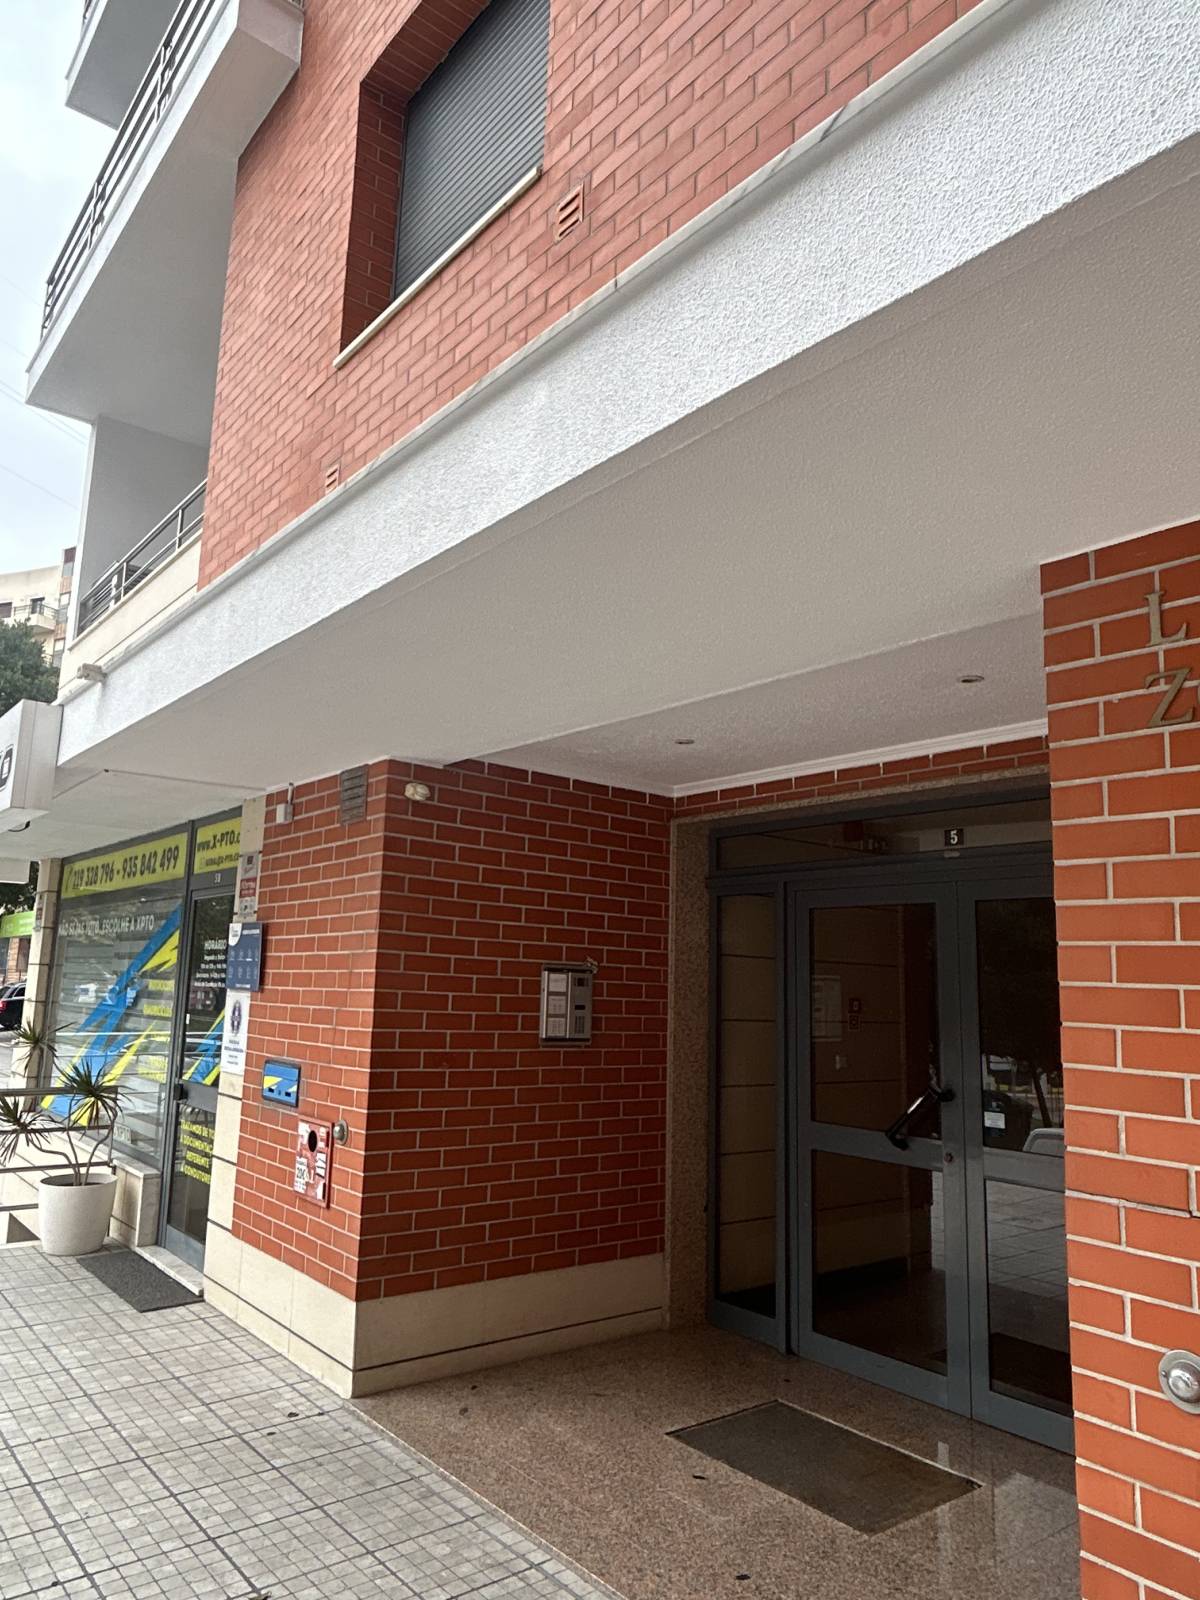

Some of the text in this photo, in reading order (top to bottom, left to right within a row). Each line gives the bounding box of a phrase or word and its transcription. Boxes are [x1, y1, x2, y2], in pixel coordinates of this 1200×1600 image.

[1144, 667, 1200, 728] Z
[950, 830, 958, 844] 5
[100, 859, 114, 883] 796
[122, 855, 139, 879] 935
[140, 850, 158, 876] 842
[160, 844, 179, 872] 499
[136, 914, 155, 931] XPTO
